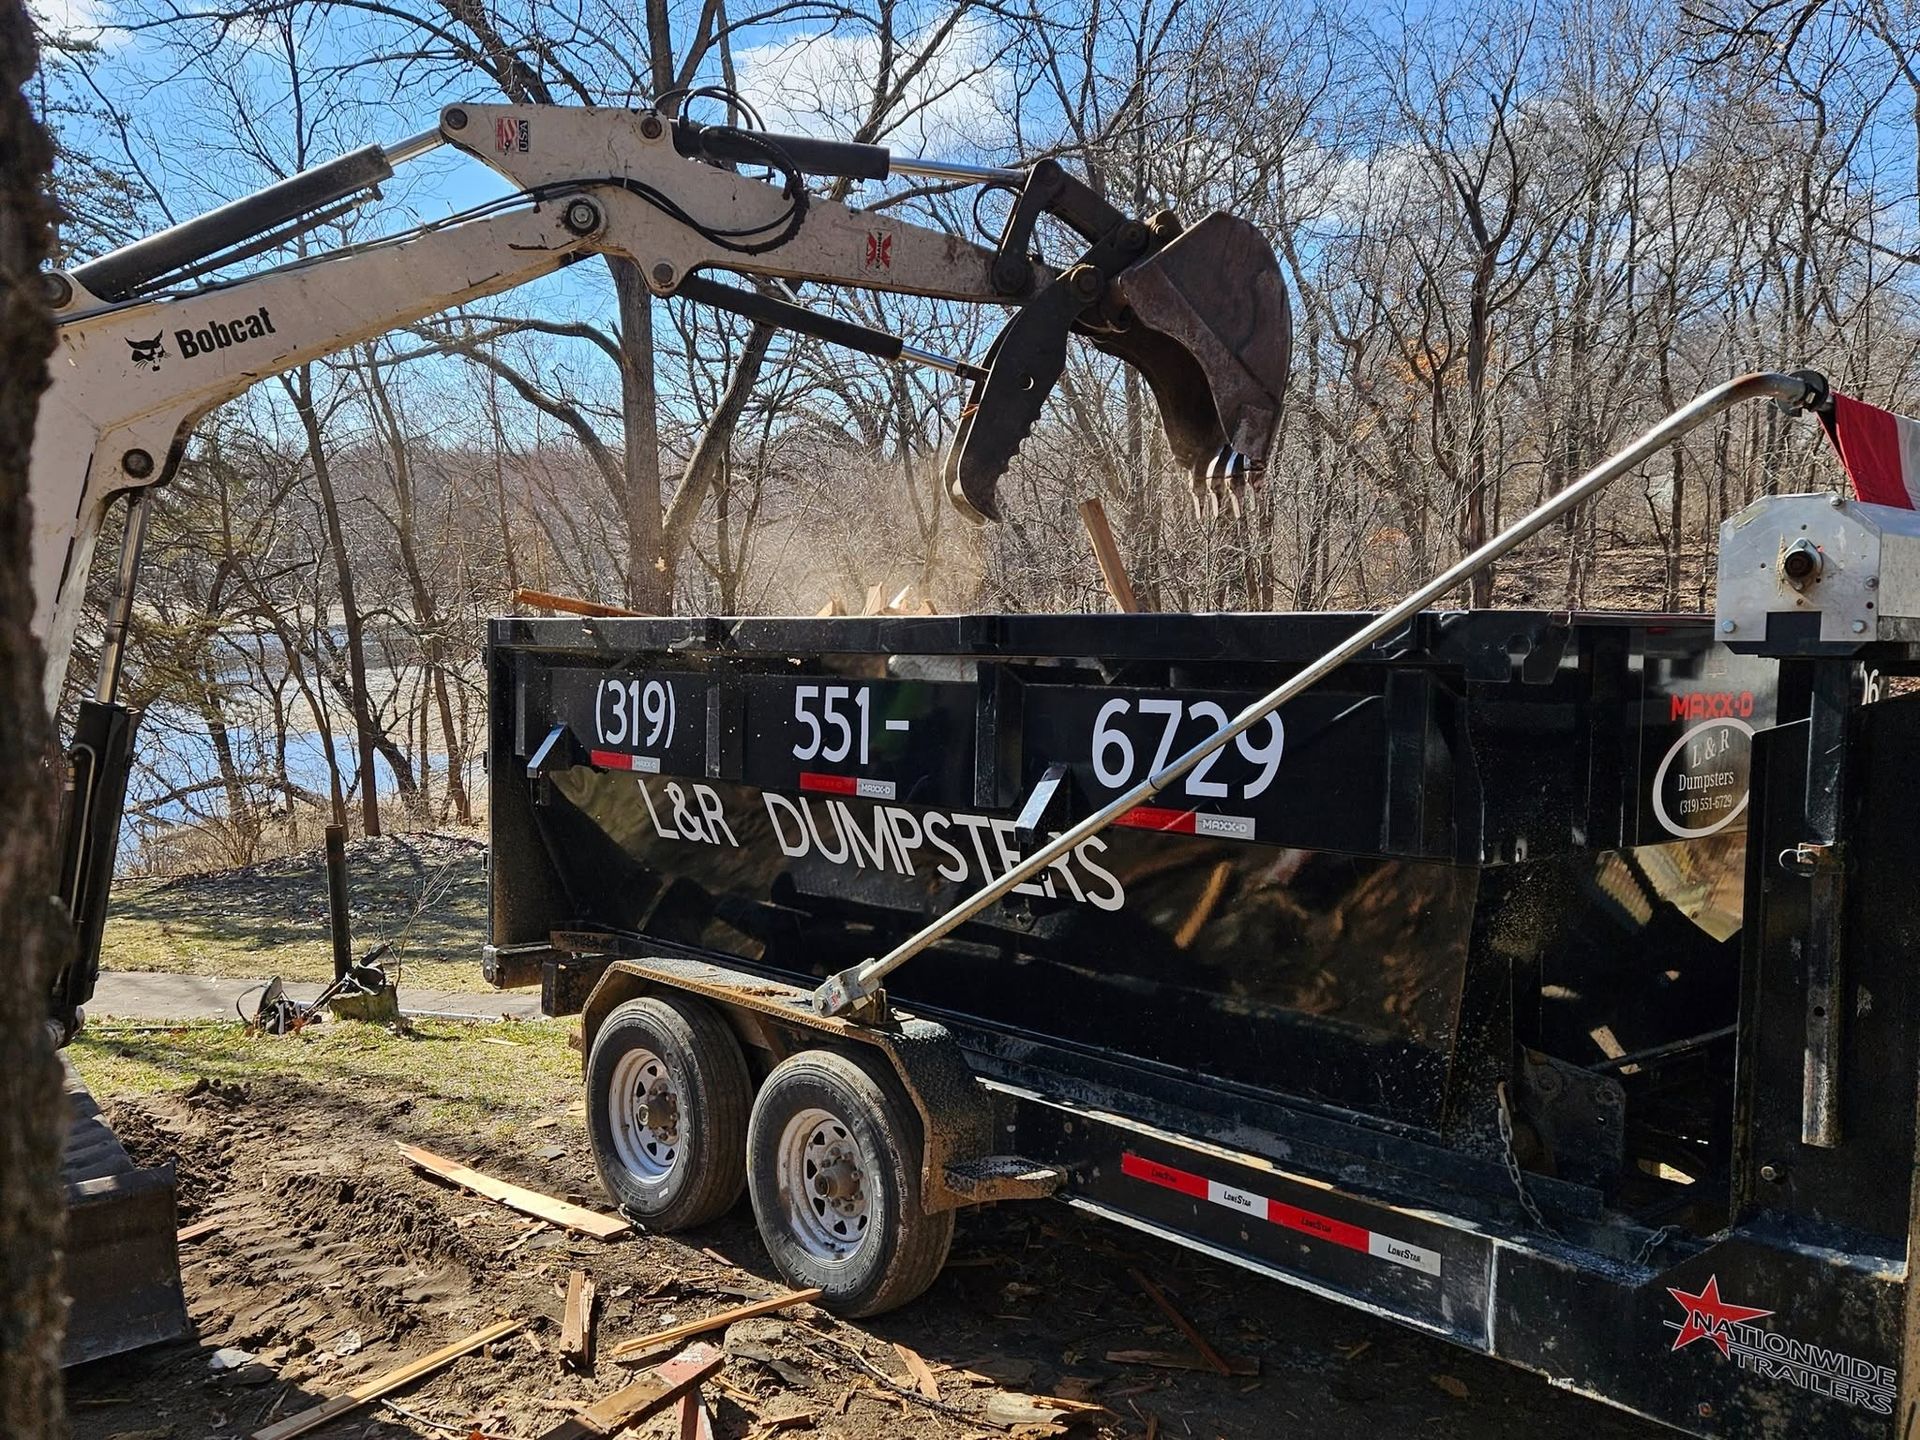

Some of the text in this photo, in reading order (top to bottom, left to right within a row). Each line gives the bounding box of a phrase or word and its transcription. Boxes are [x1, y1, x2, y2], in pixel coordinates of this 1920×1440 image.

[520, 122, 528, 150] USA
[174, 307, 276, 359] Bobcat
[595, 679, 676, 749] (319)
[1092, 698, 1285, 800] 6729
[1692, 728, 1730, 769] L & R
[1678, 771, 1735, 793] Dumpsters
[1679, 794, 1733, 815] (319) 551-6729
[637, 779, 1125, 912] L&R DUMPSTERS
[1692, 1309, 1897, 1392] NATIONWIDE
[1734, 1351, 1893, 1415] TRAILERS
